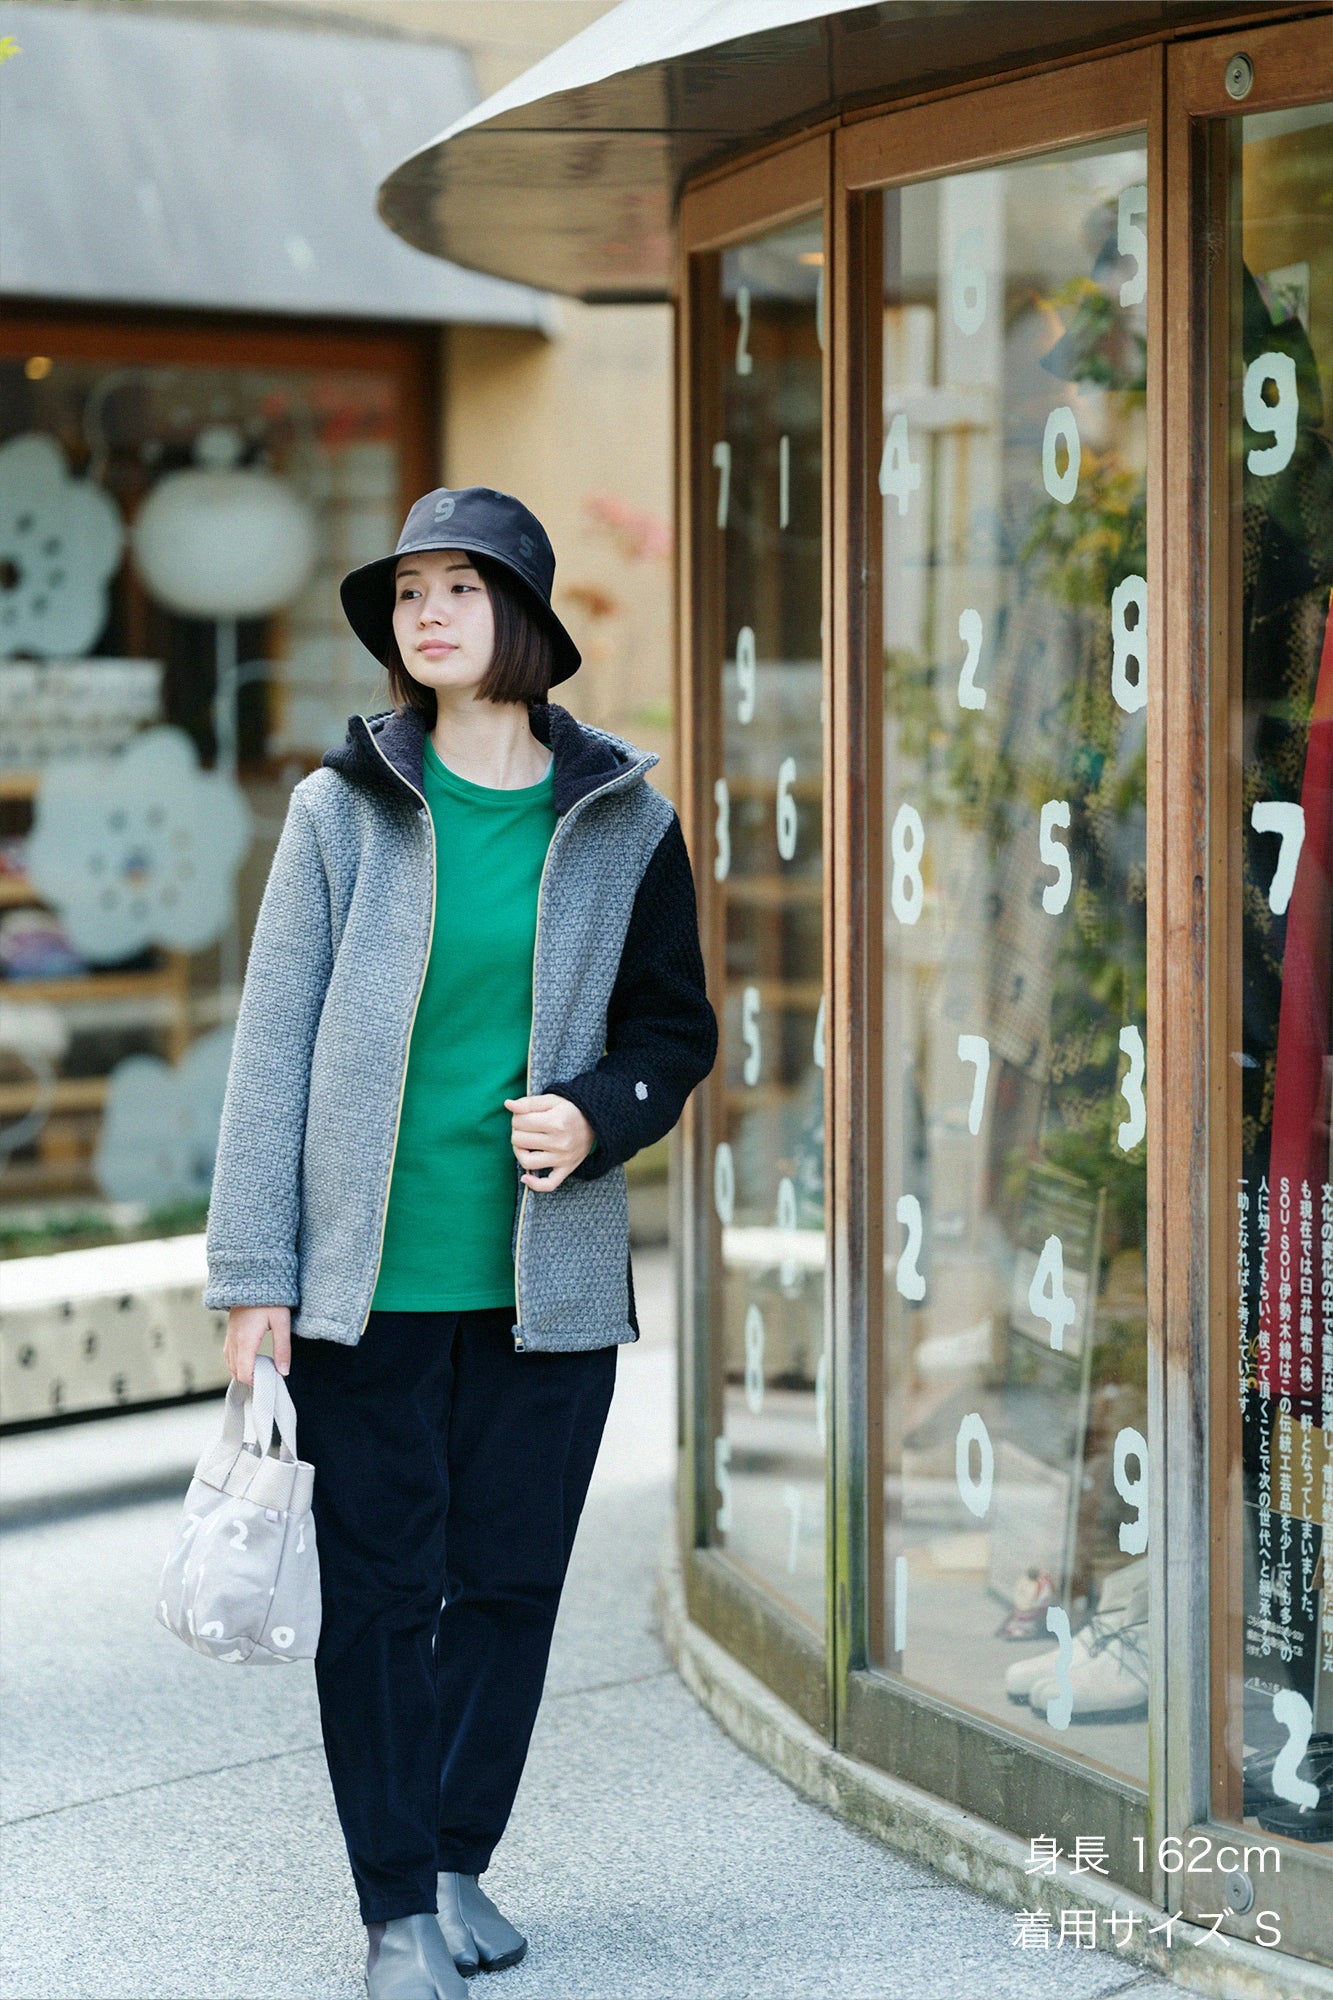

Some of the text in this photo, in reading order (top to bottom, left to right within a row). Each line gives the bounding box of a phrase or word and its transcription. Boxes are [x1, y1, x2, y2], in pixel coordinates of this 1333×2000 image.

[952, 226, 988, 336] 6
[1118, 185, 1148, 307] 5
[736, 285, 753, 376] 2
[879, 413, 922, 516] 4
[1042, 406, 1081, 505] 0
[1243, 351, 1299, 477] 9
[434, 497, 456, 523] 9
[712, 440, 732, 531] 7
[735, 625, 757, 726] 9
[957, 608, 987, 711] 2
[1111, 574, 1148, 714] 8
[714, 776, 731, 884] 3
[776, 756, 797, 861] 6
[1039, 799, 1073, 916] 5
[1250, 800, 1306, 916] 7
[891, 802, 925, 925] 8
[742, 985, 761, 1087] 5
[957, 1034, 990, 1136] 7
[1117, 1024, 1147, 1153] 3
[713, 1141, 736, 1228] 0
[896, 1193, 927, 1301] 2
[1028, 1233, 1076, 1352] 4
[744, 1303, 765, 1416] 8
[714, 1435, 732, 1532] 5
[955, 1412, 995, 1519] 0
[1112, 1426, 1149, 1556] 9
[229, 1519, 249, 1551] 2
[271, 1625, 296, 1649] 0
[1046, 1604, 1074, 1731] 3
[1271, 1688, 1321, 1810] 2
